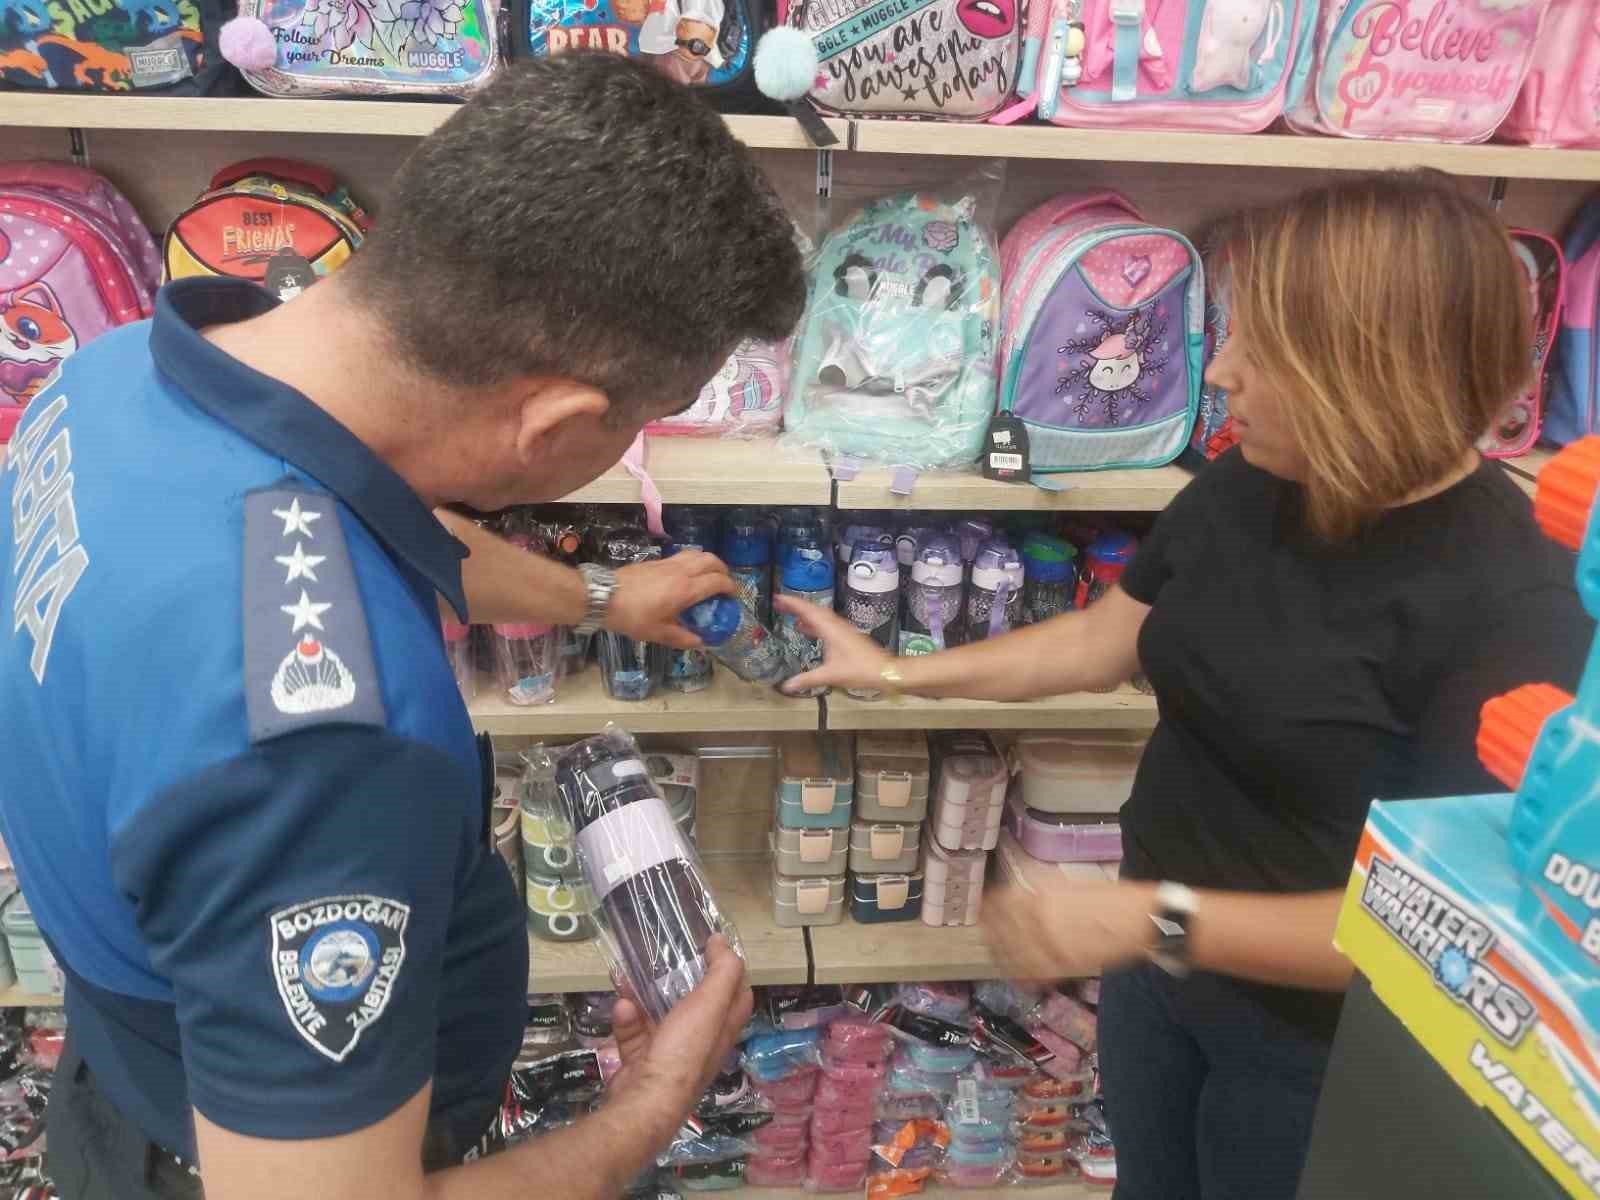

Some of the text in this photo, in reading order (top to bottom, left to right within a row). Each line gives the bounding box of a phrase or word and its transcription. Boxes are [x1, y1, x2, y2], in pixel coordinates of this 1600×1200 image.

[273, 27, 321, 44] Follow
[817, 30, 849, 55] GGLE
[861, 2, 911, 30] MUGGLE
[829, 43, 888, 101] you
[893, 9, 943, 53] are
[1352, 0, 1496, 63] Believe
[286, 49, 386, 68] your Dreams
[407, 51, 463, 69] MUGGLE
[861, 30, 981, 100] awesome
[922, 46, 1008, 108] today
[1391, 64, 1513, 99] yourself
[241, 211, 273, 226] BEST
[8, 366, 90, 686] ABITA
[1389, 866, 1493, 962] WATER
